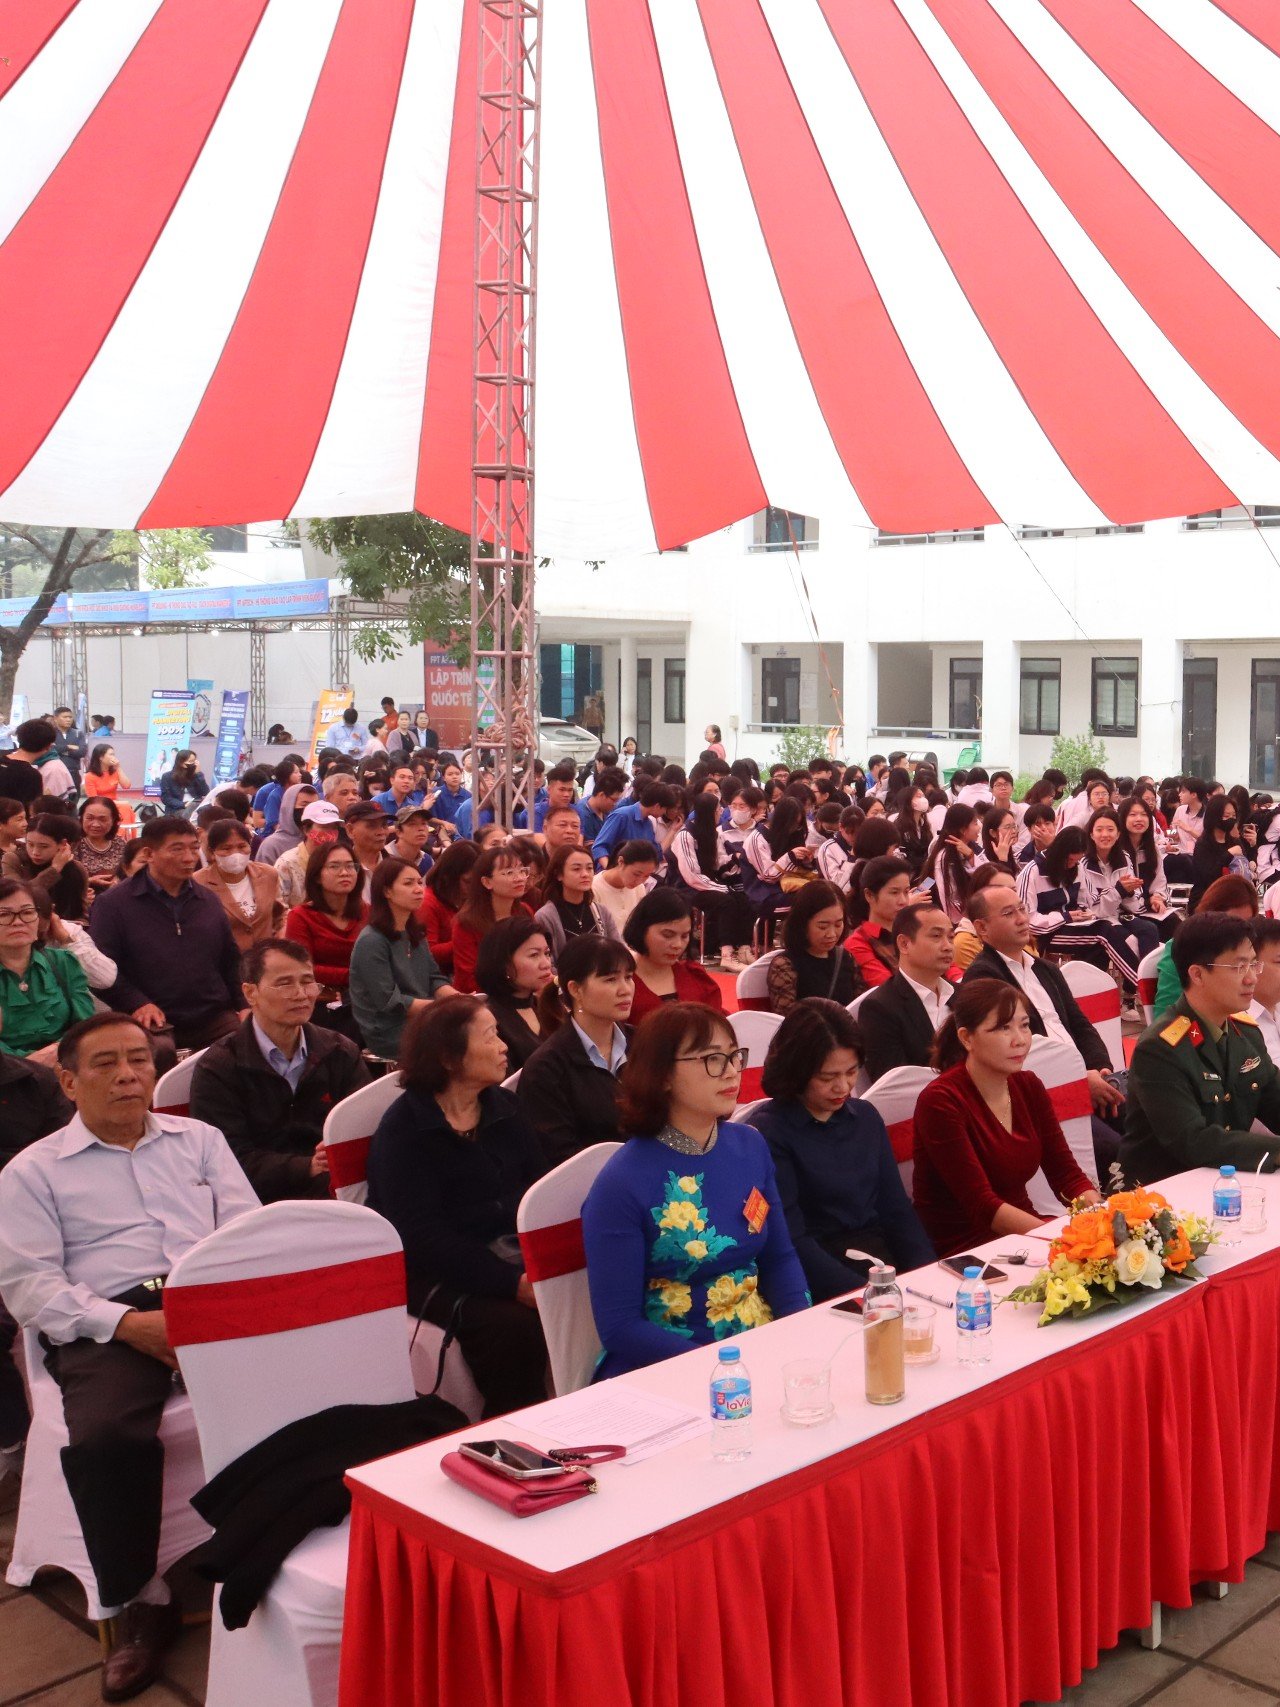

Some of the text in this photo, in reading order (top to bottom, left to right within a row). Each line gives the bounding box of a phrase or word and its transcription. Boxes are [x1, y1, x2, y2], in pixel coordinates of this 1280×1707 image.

[430, 668, 473, 688] LẬP TRÌN
[431, 688, 459, 706] QUỐC
